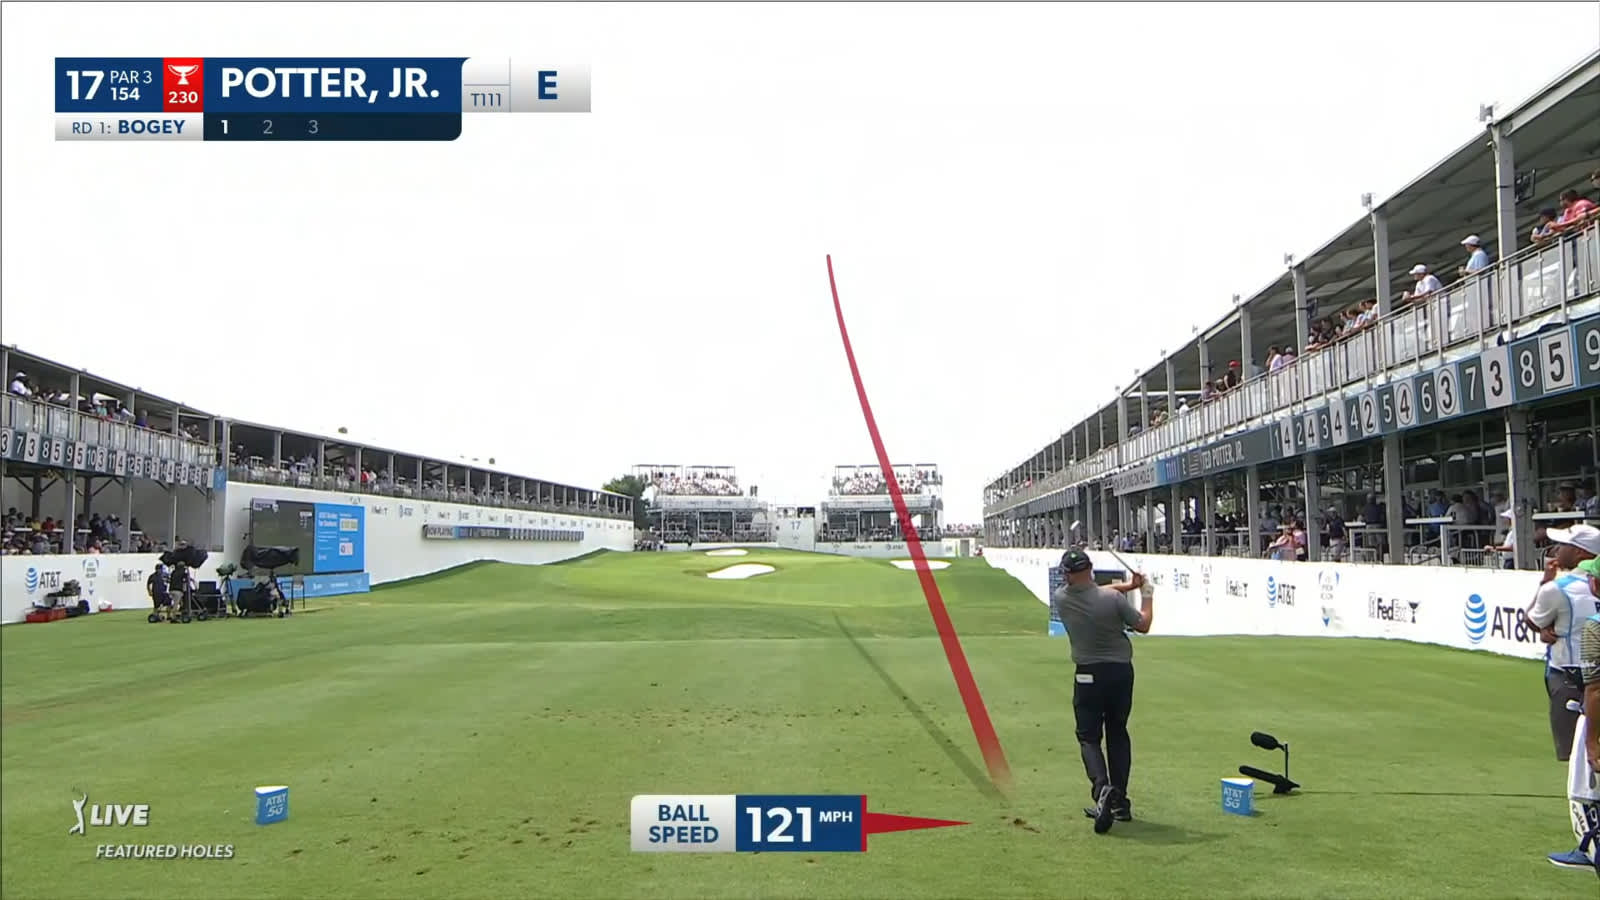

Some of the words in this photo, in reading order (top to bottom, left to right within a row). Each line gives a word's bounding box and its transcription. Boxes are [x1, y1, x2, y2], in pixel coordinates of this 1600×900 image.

[1284, 426, 1291, 450] 4
[1296, 422, 1304, 446] 2
[1307, 419, 1315, 444] 4
[1321, 414, 1329, 440] 3
[1334, 409, 1342, 437] 4
[1350, 404, 1359, 431] 4
[1364, 400, 1374, 429] 2
[1383, 394, 1393, 423] 5
[1400, 388, 1411, 419] 4
[1420, 381, 1433, 413] 6
[1440, 375, 1453, 409] 3
[1465, 366, 1478, 401] 7
[1489, 359, 1504, 397] 3
[1519, 349, 1536, 388] 8
[1548, 341, 1565, 382] 5
[1585, 328, 1600, 371] 9
[1, 433, 9, 453] 3
[16, 436, 24, 455] 7
[28, 438, 36, 457] 3
[42, 441, 50, 458] 8
[53, 442, 61, 462] 5
[66, 445, 74, 462] 9
[77, 447, 84, 465] 5
[87, 449, 97, 467] 10
[98, 451, 105, 468] 3
[108, 452, 116, 470] 11
[118, 455, 124, 472] 4
[39, 571, 61, 588] AT&T
[1277, 583, 1297, 607] AT&T
[266, 804, 284, 817] 5G
[1225, 796, 1240, 809] 5G
